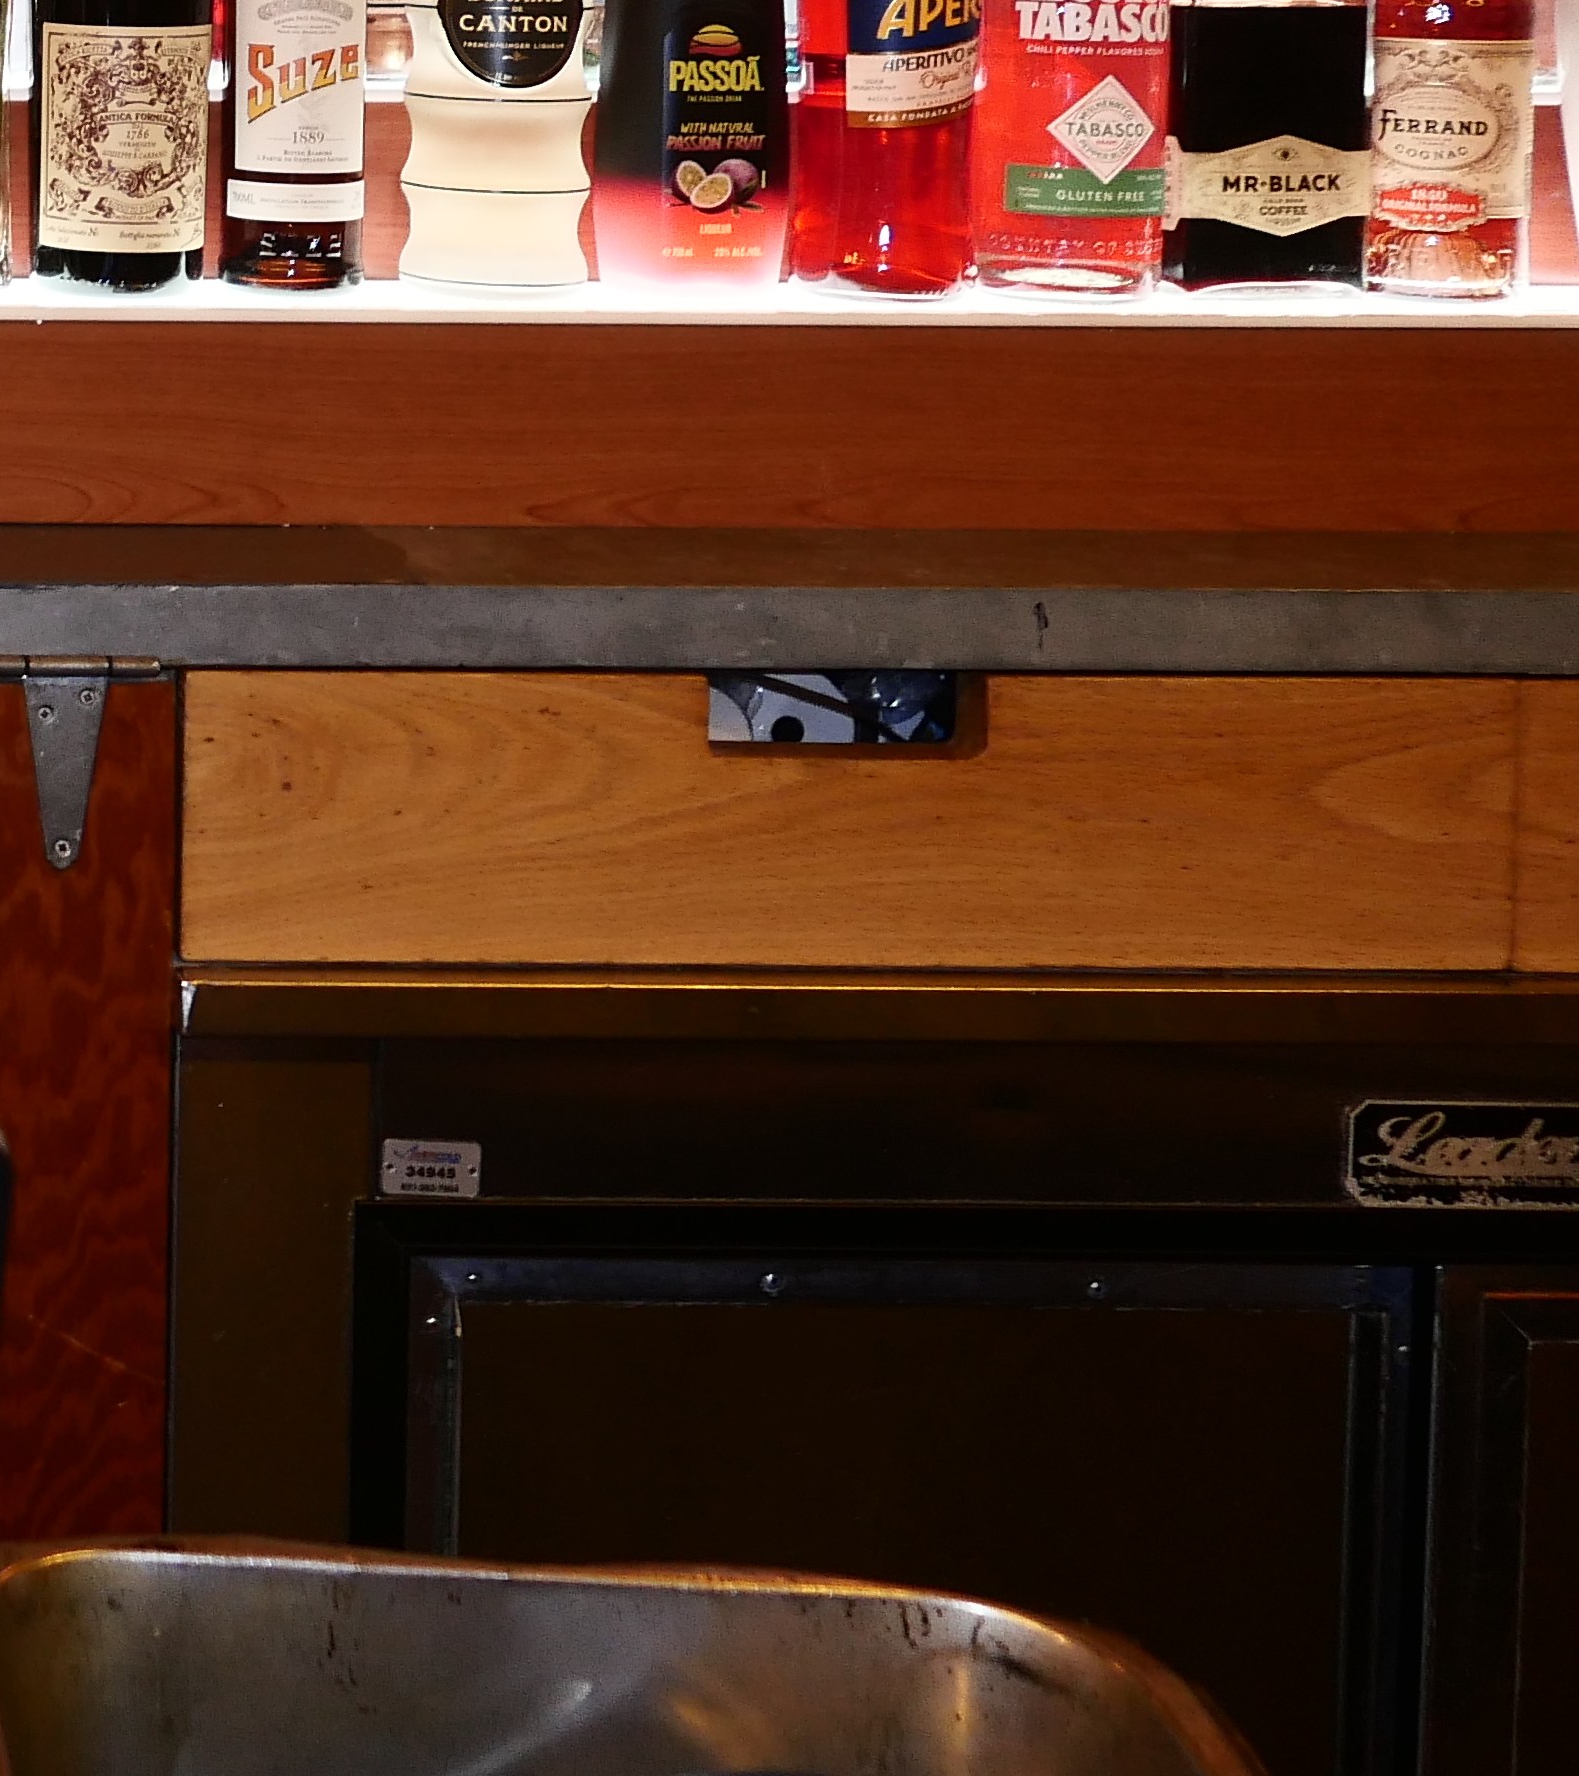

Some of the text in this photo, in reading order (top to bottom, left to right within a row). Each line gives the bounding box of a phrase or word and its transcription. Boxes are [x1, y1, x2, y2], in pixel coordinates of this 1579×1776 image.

[459, 13, 568, 32] CANTON
[1014, 1, 1169, 43] TABASCO
[883, 48, 966, 73] APERITIVO
[247, 43, 359, 124] Suze
[99, 112, 175, 123] ANTICA FORMULA
[1378, 108, 1488, 140] FERRAND
[680, 122, 754, 134] WITH NATURAL
[1066, 122, 1144, 138] TABASCO
[291, 130, 326, 145] 1889
[726, 134, 766, 150] FRUIT
[1394, 143, 1468, 160] COGNAC
[1055, 190, 1145, 202] GLUTEN FREE
[1258, 204, 1308, 216] COFFEE
